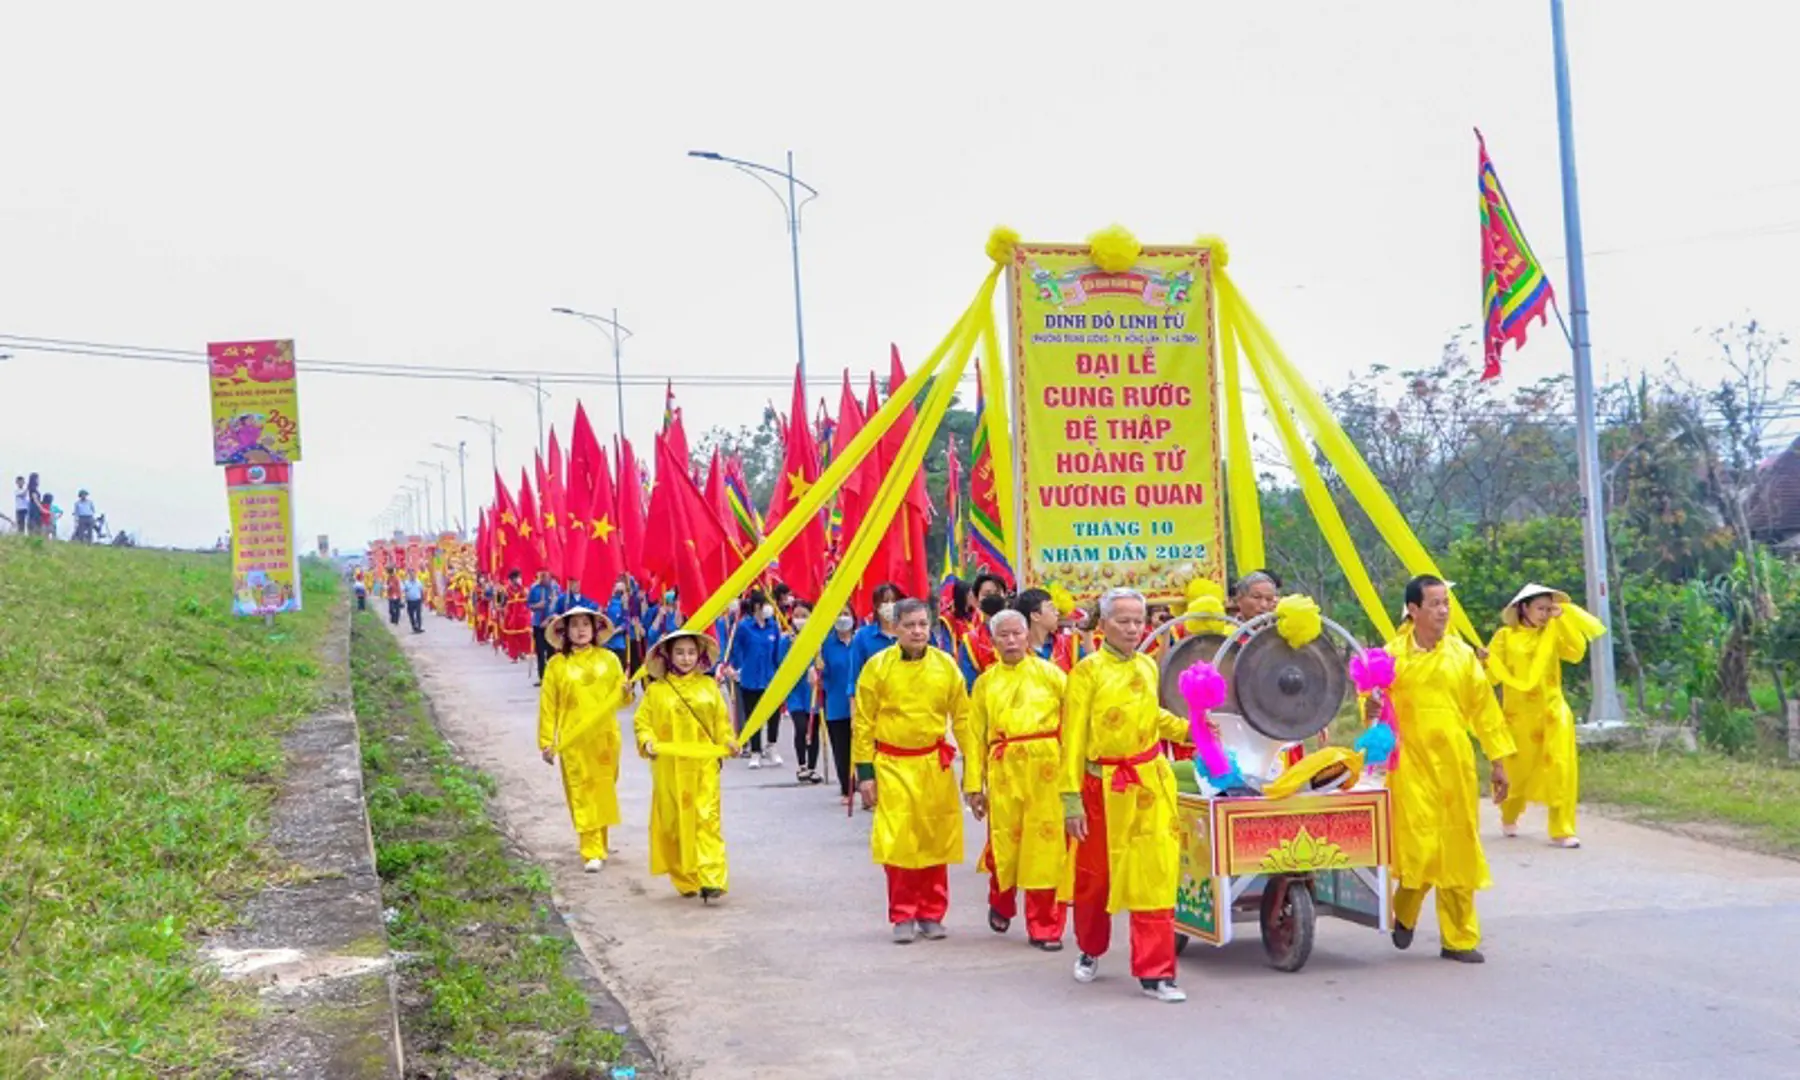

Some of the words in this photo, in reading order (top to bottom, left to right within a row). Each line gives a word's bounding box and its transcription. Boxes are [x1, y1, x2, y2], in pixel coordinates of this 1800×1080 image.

[1046, 314, 1085, 329] DINH
[1120, 314, 1157, 329] LINH
[1076, 354, 1119, 379] ĐẠI
[1128, 347, 1157, 375] LỄ
[1044, 386, 1114, 408] CUNG
[1124, 382, 1191, 407] RƯỚC
[1065, 415, 1097, 445] ĐỆ
[1107, 415, 1171, 444] THẬP
[1057, 448, 1144, 473] HOÀNG
[1153, 444, 1186, 472] TỬ
[1039, 484, 1126, 507] VƯƠNG
[1135, 484, 1203, 508] QUAN
[1072, 519, 1140, 536] THÁNG
[1151, 521, 1174, 536] 10
[1042, 546, 1100, 562] NHÂM
[1156, 544, 1206, 559] 2022
